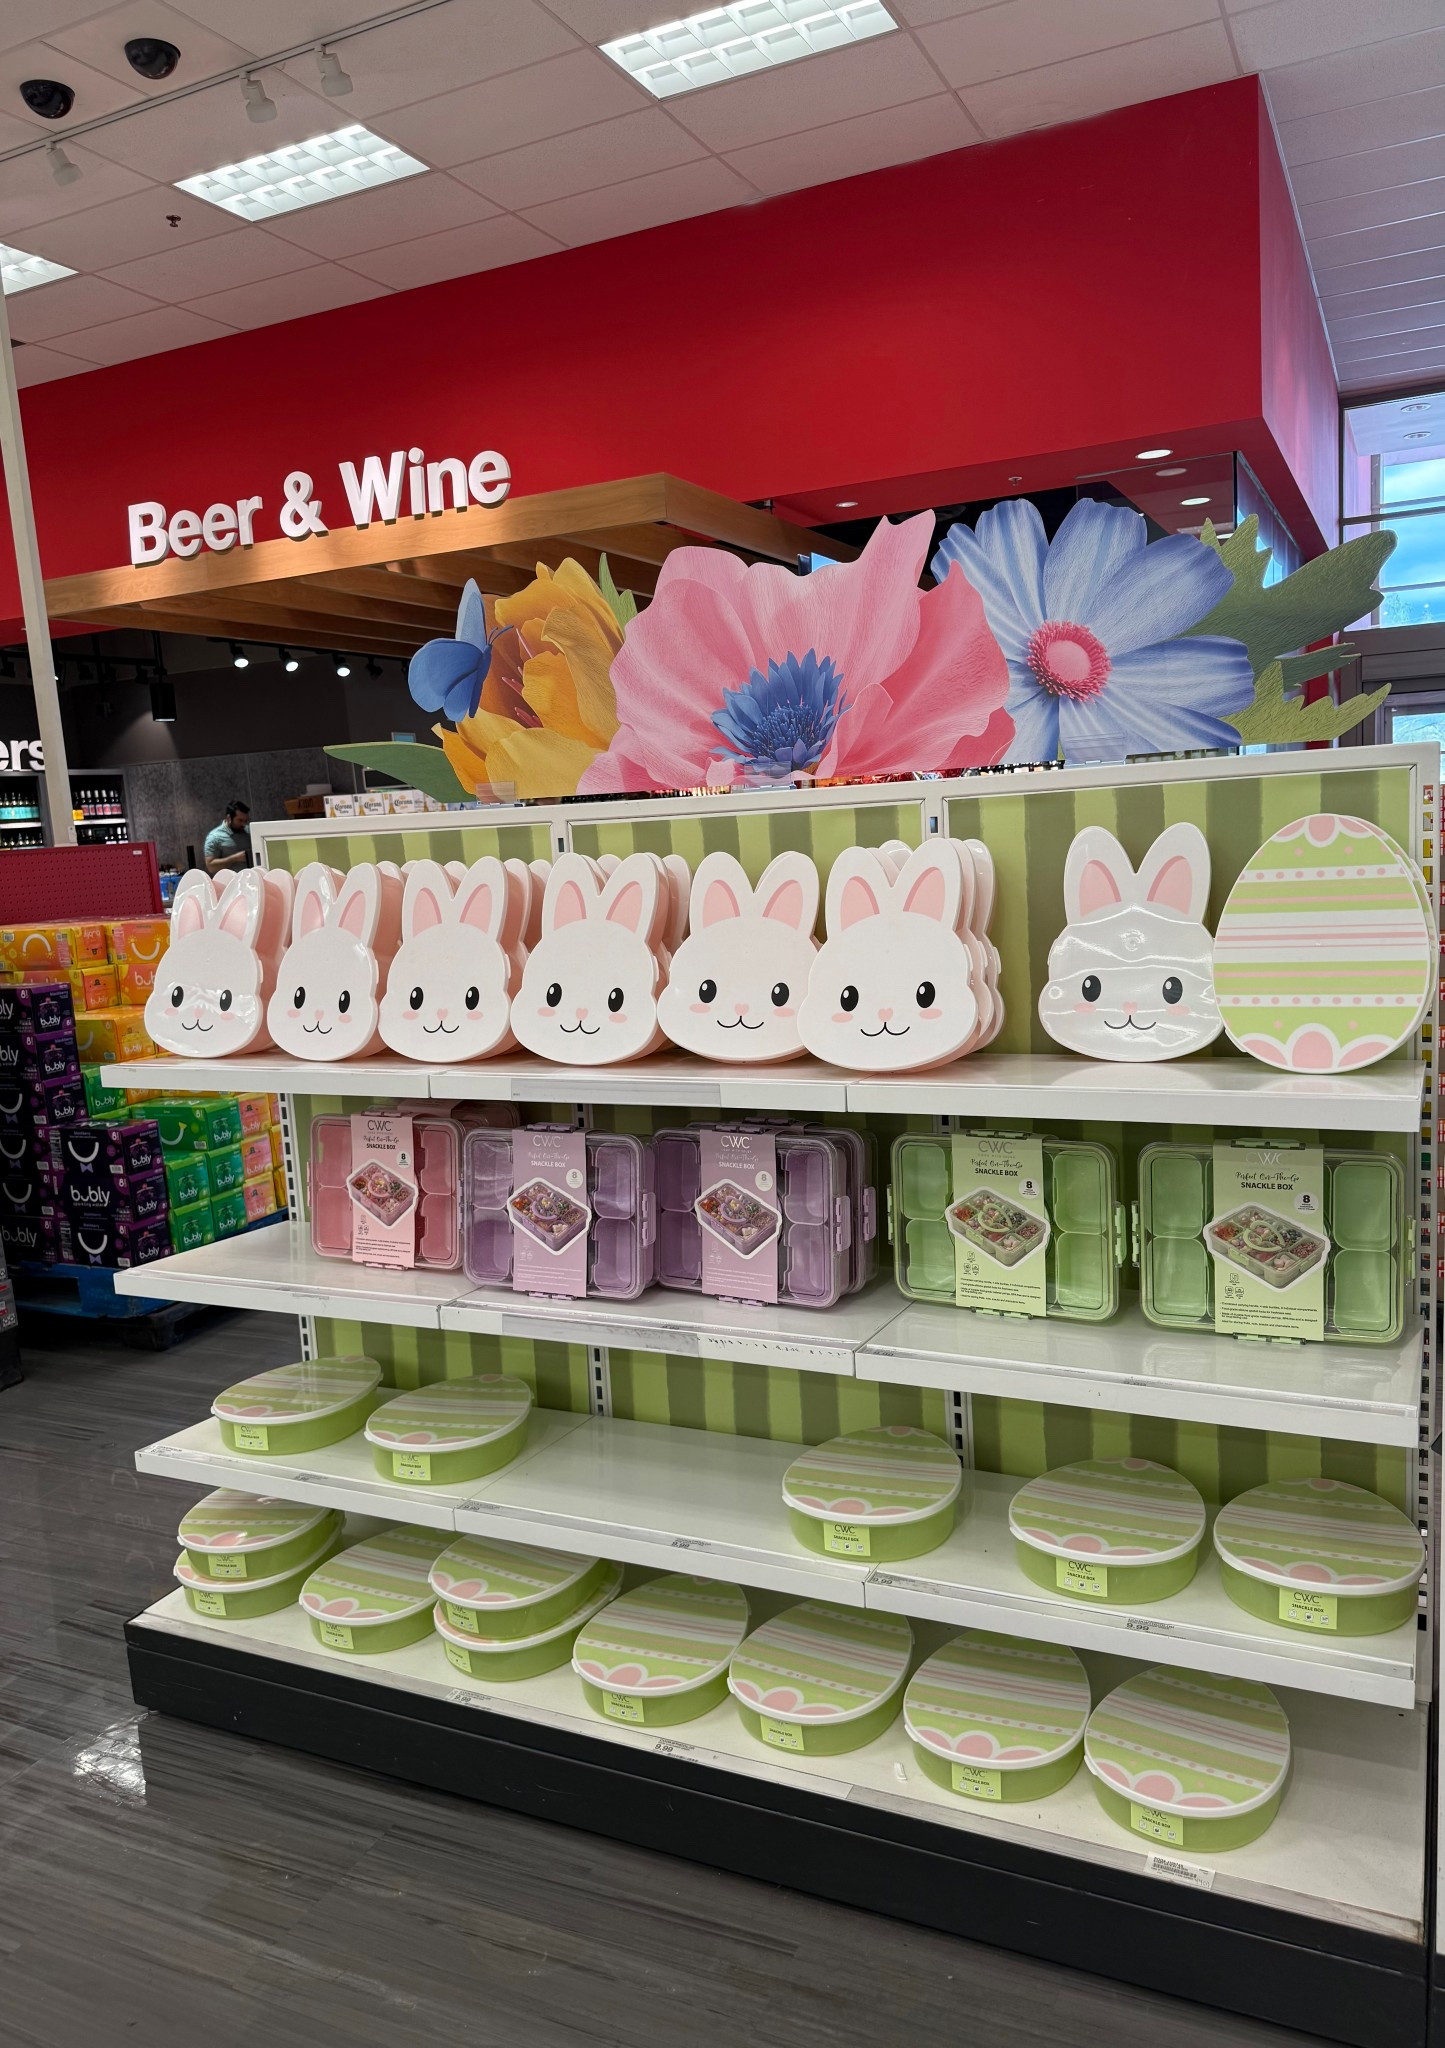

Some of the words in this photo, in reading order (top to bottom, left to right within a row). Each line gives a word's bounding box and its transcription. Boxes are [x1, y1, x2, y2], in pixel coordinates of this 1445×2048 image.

[127, 496, 263, 565] Beer
[279, 471, 329, 538] &
[338, 447, 511, 529] Wine
[134, 970, 155, 986] bub
[368, 1120, 392, 1131] CWC
[532, 1134, 561, 1148] CWC
[720, 1135, 750, 1149] CWC
[978, 1140, 1013, 1154] CWC
[1241, 1182, 1275, 1190] SNACKLE
[70, 1185, 110, 1207] bubly
[1303, 1195, 1310, 1203] 8
[2, 1226, 37, 1248] bubly
[835, 1524, 855, 1534] CWC
[1069, 1561, 1092, 1572] CWC
[1294, 1592, 1320, 1604] CWC
[1292, 1603, 1313, 1611] SNACKLE
[655, 1744, 674, 1752] 9.99
[964, 1766, 986, 1778] CWC
